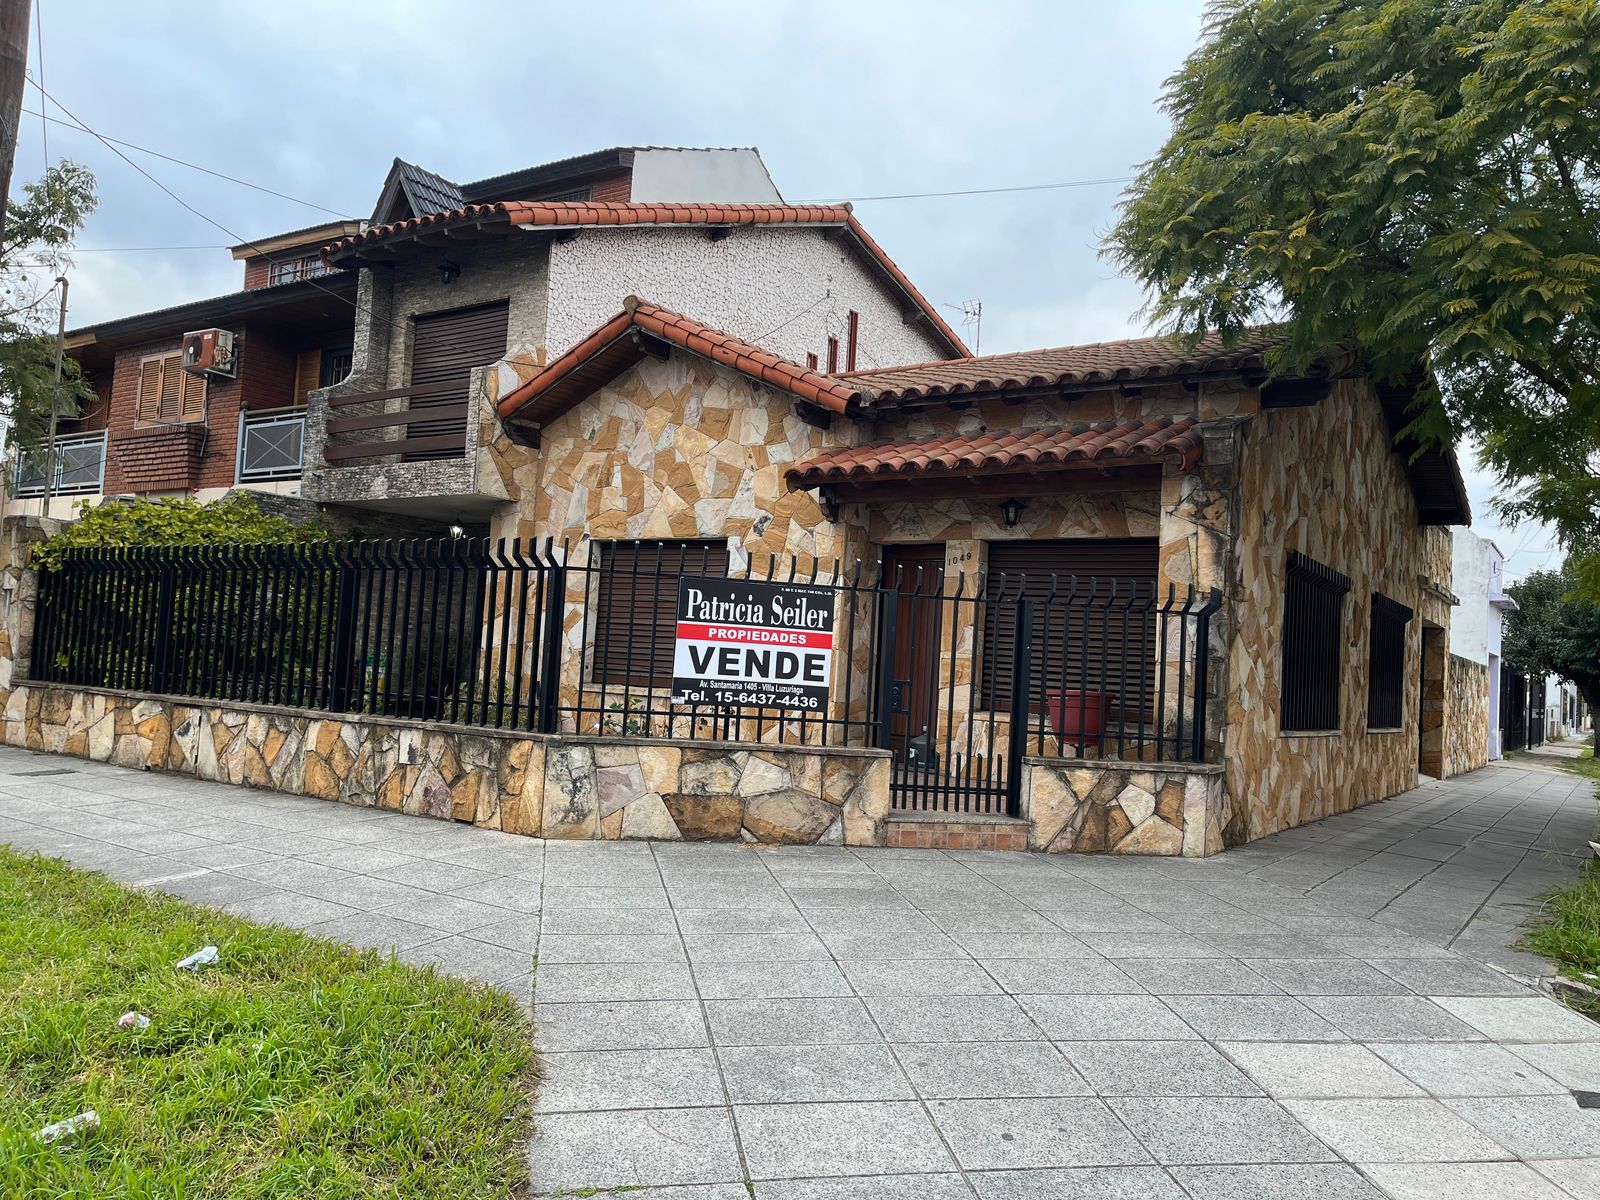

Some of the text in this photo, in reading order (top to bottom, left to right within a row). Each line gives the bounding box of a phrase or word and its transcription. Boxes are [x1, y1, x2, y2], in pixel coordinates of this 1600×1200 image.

[948, 552, 972, 566] 1049
[685, 588, 828, 629] Patricia Seiler
[708, 628, 807, 645] PROPIEDADES
[688, 645, 826, 683] VENDE
[699, 679, 709, 688] Av.
[744, 683, 758, 691] 1405
[762, 683, 775, 692] Villa
[775, 684, 804, 695] Luzuriaga
[681, 689, 709, 701] Tel.
[715, 691, 818, 708] 15-6437-4436
